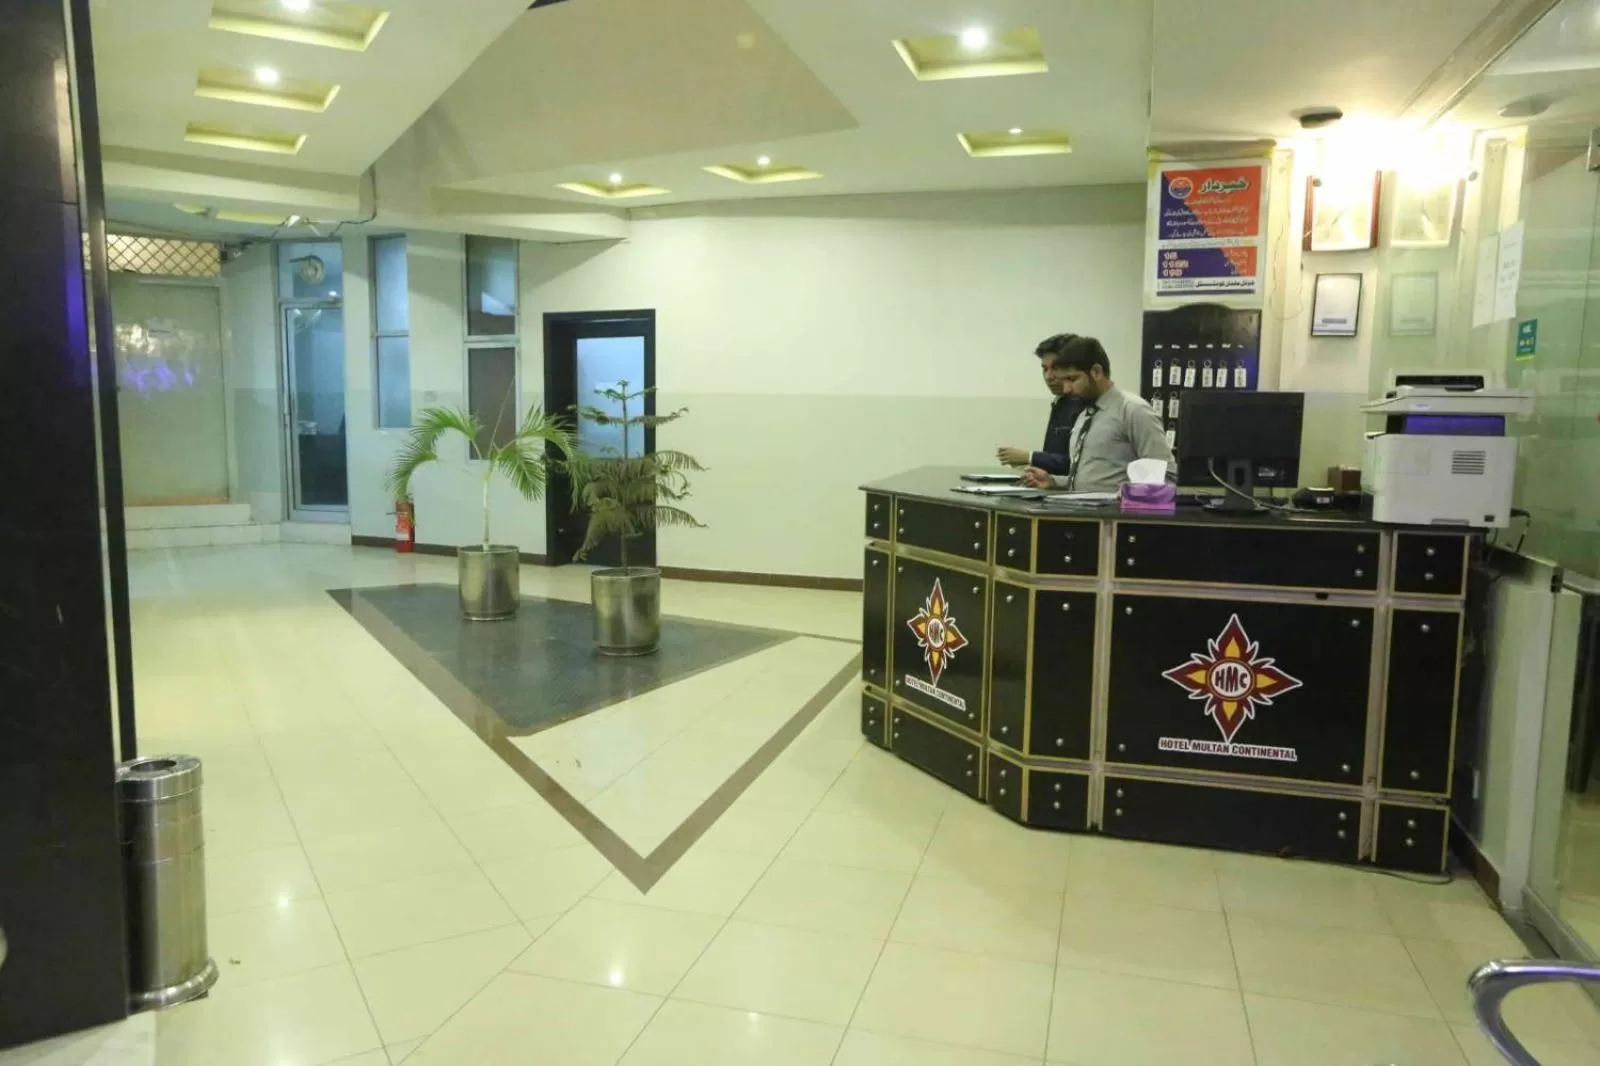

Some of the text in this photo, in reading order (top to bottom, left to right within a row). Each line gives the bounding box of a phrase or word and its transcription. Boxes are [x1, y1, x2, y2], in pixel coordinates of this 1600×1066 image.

[1215, 665, 1248, 693] HMC
[1160, 738, 1297, 760] HOTEL MULTAN CONTINENTAL
